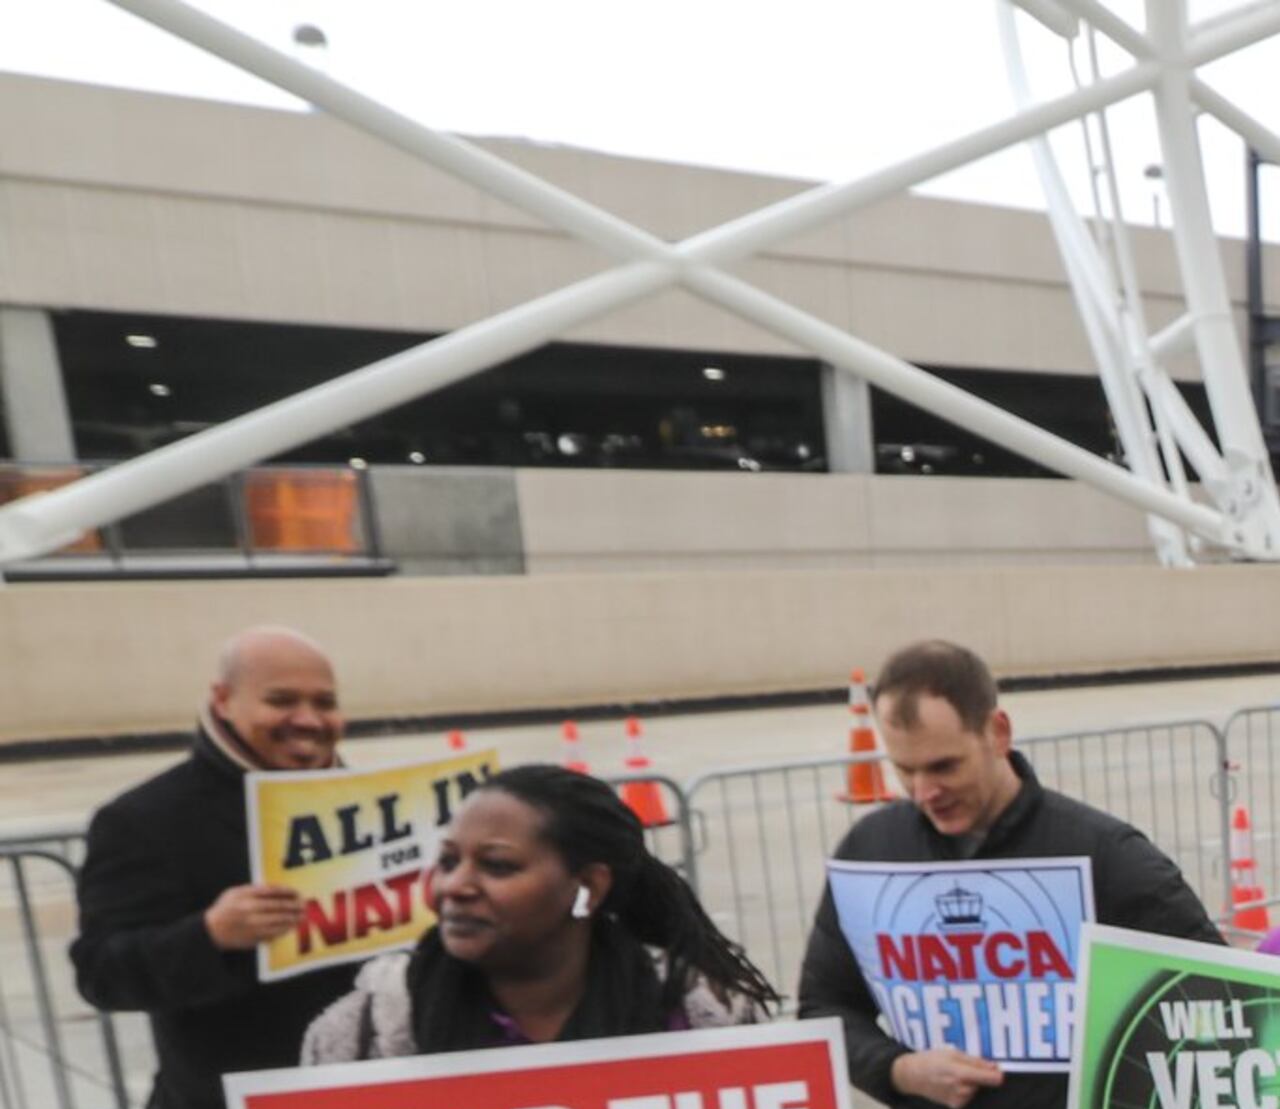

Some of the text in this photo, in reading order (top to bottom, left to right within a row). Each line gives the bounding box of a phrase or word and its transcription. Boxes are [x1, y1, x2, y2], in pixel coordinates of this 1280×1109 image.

[283, 794, 411, 870] ALL
[876, 930, 1075, 983] NATCA
[1159, 999, 1253, 1041] WILL
